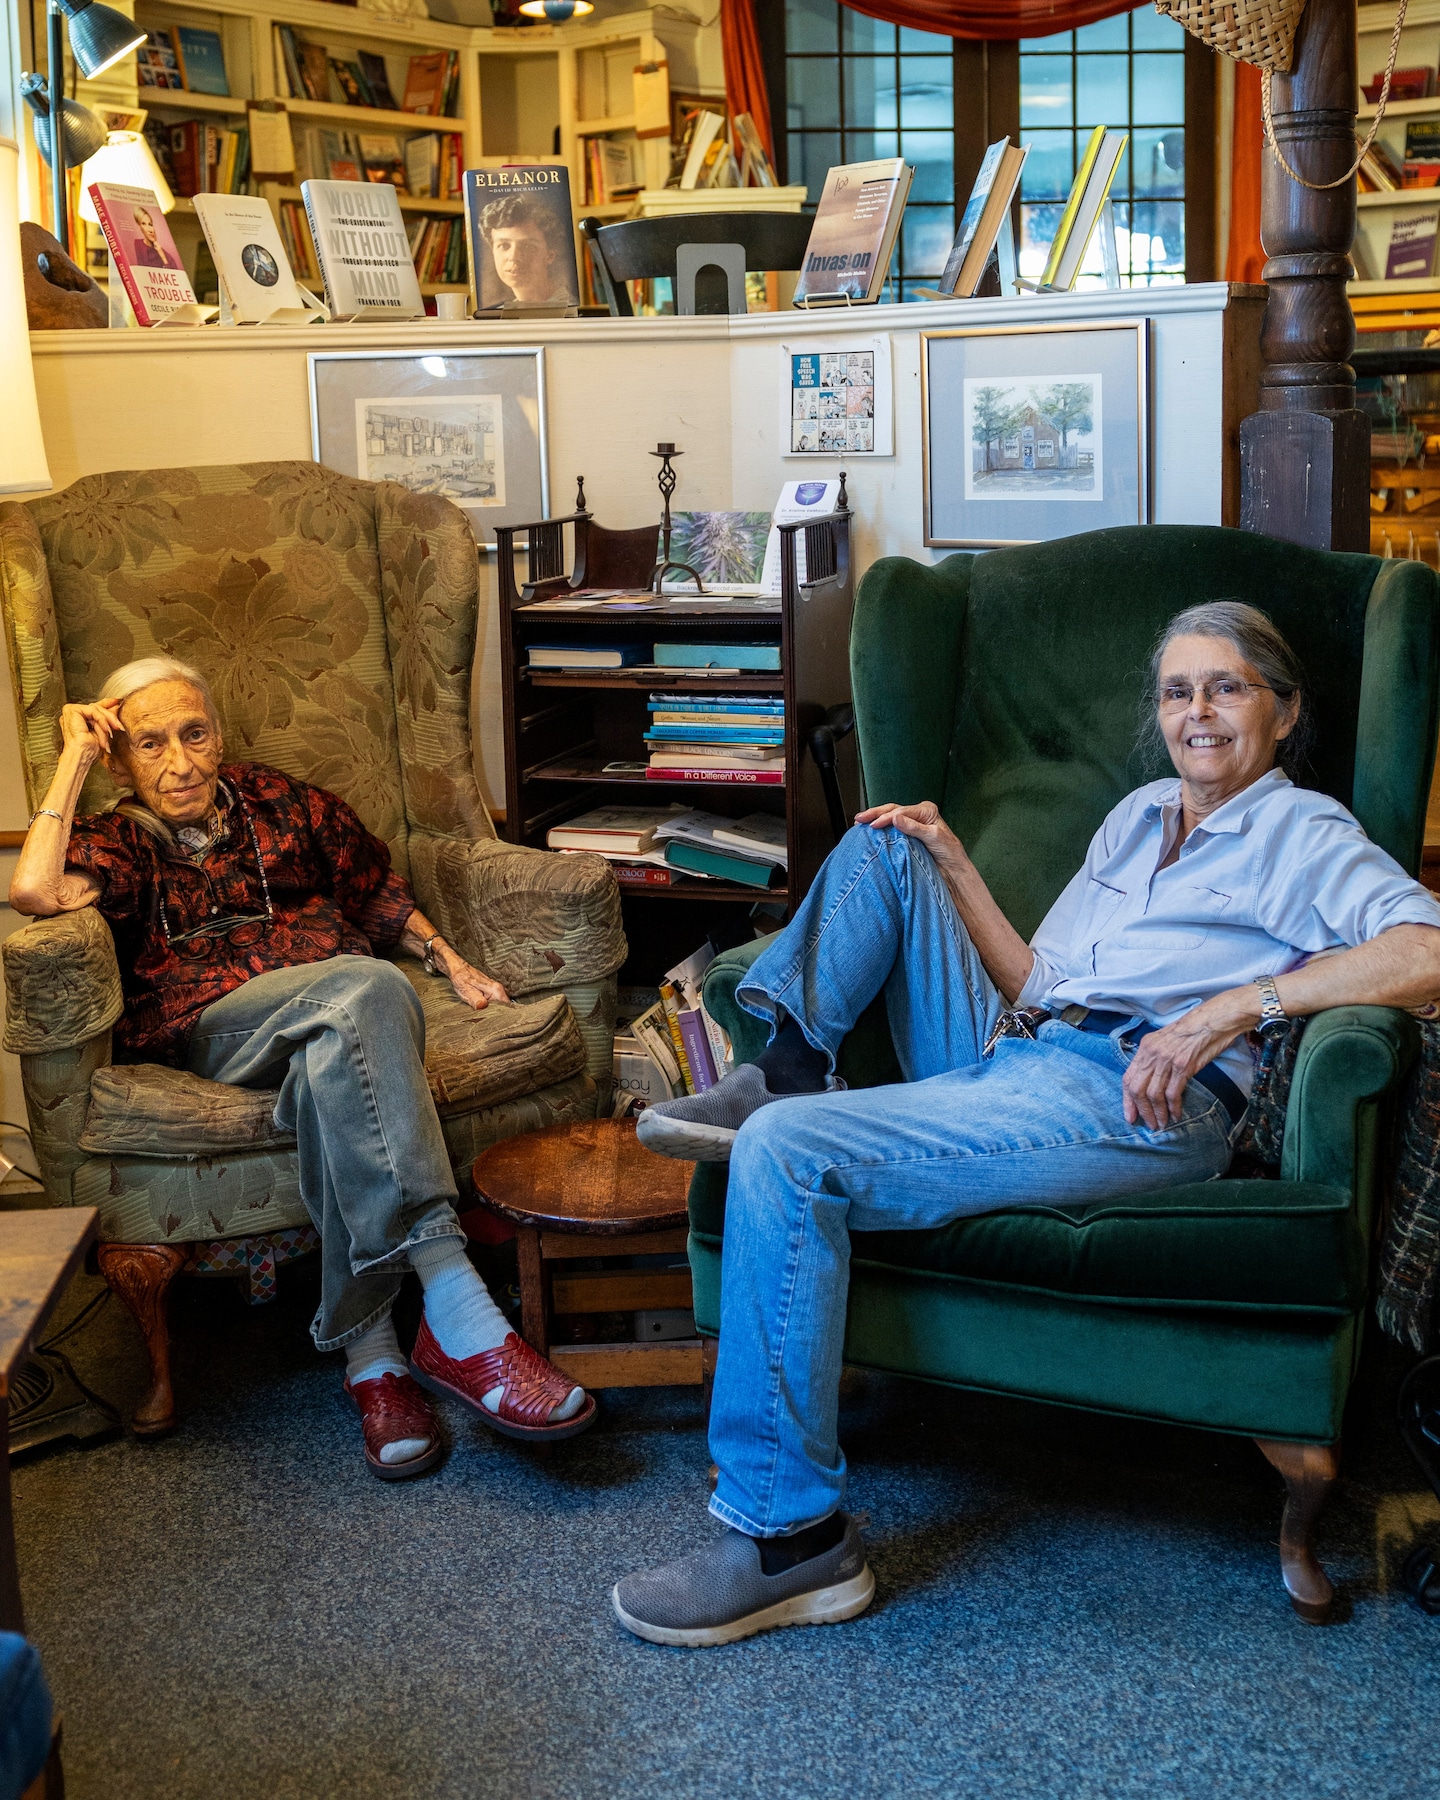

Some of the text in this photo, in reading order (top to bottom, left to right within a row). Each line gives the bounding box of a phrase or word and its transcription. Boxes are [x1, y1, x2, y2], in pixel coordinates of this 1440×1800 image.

[475, 170, 560, 186] ELEANOR
[325, 190, 390, 218] WORLD
[92, 196, 121, 258] MAKE TROUBLE
[350, 219, 386, 227] EXISTENTIAL
[326, 230, 407, 258] WITHOUT
[342, 258, 362, 266] THREAT
[806, 252, 872, 272] Invasion
[119, 263, 138, 305] CECILE RICHARDS
[148, 272, 179, 286] MAKE
[350, 270, 401, 297] MIND
[144, 286, 194, 302] TROUBLE
[701, 771, 733, 780] Different
[735, 773, 756, 781] Voice
[689, 1034, 701, 1072] Ingredients
